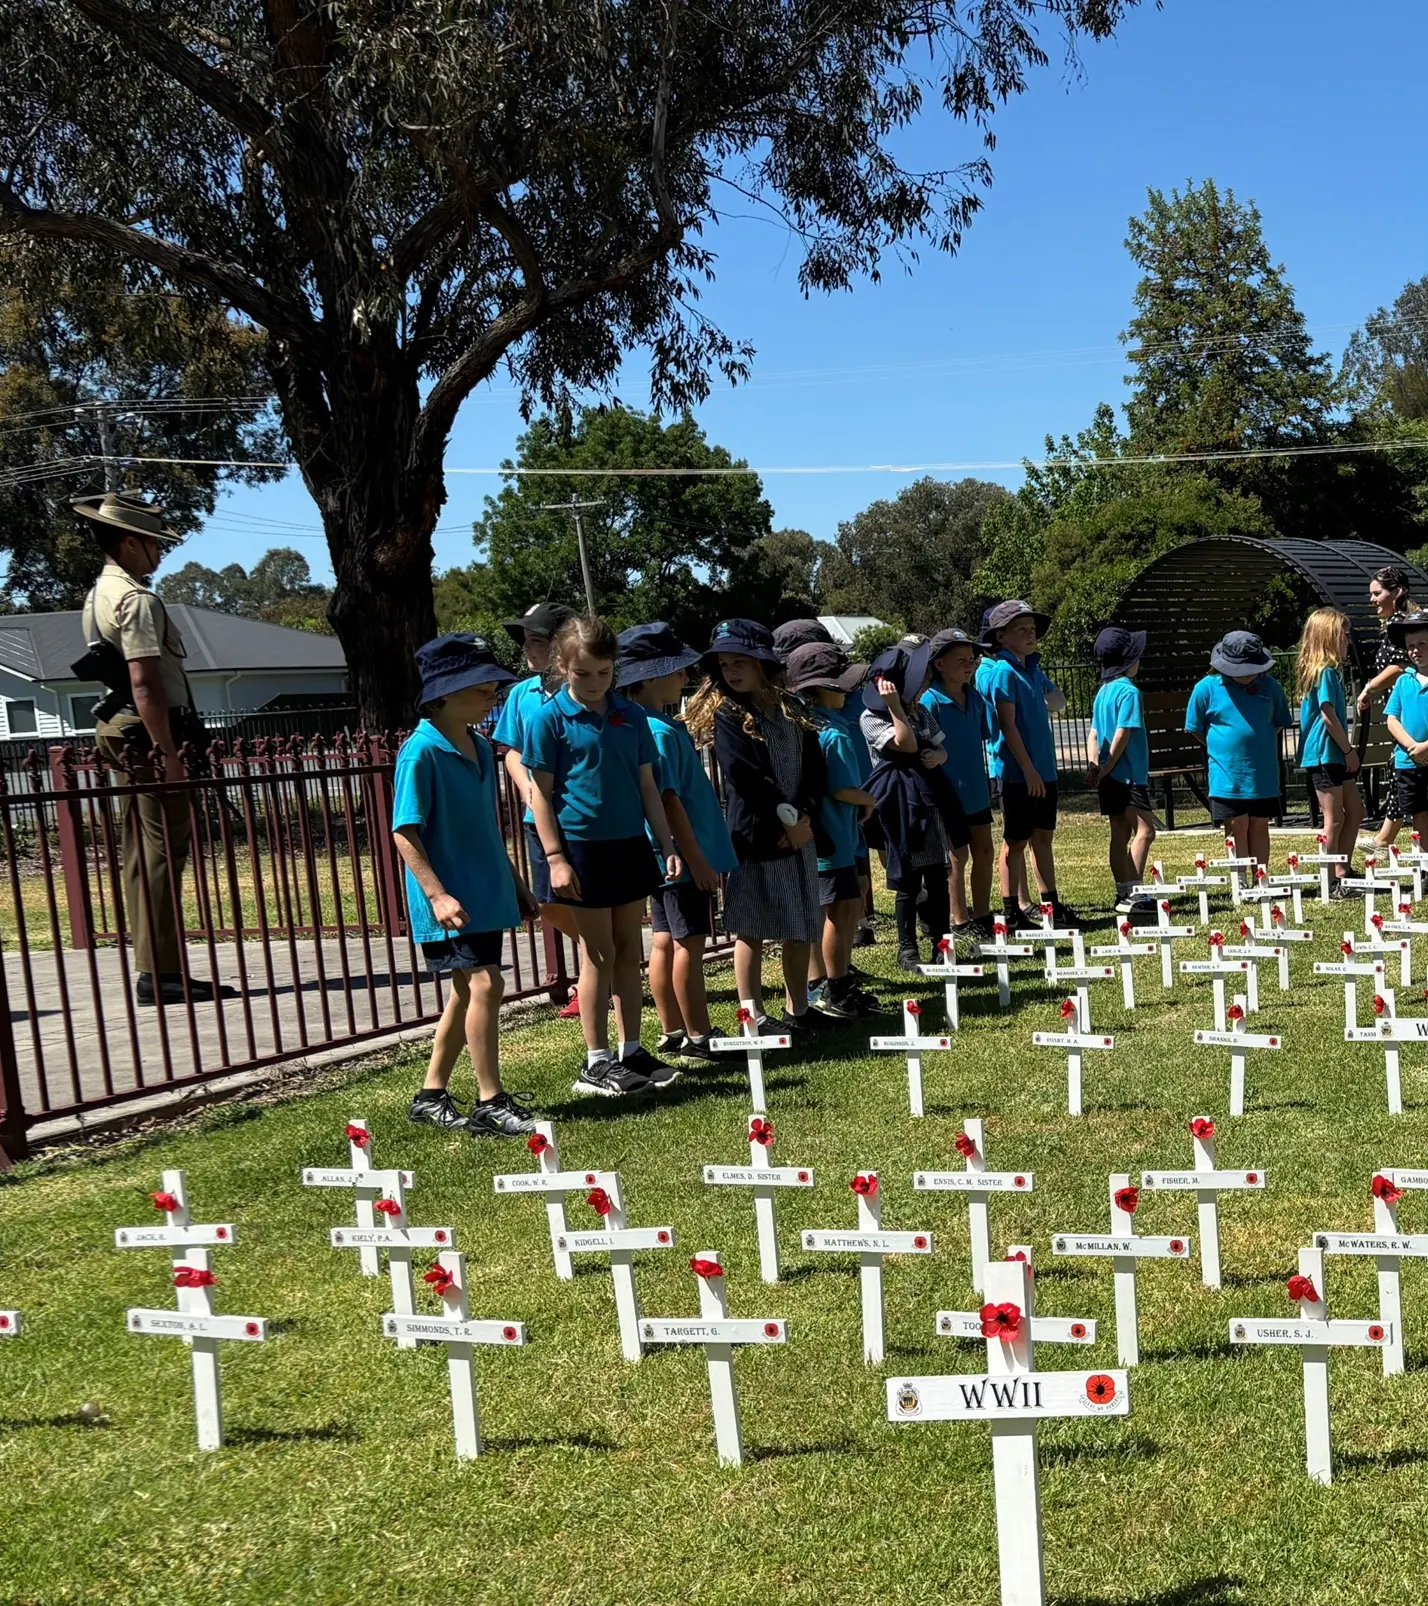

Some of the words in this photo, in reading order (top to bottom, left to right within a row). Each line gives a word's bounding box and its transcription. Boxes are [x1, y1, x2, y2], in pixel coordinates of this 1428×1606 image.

[723, 1172, 746, 1180] ELMES,
[757, 1173, 781, 1181] SISTER
[1161, 1177, 1189, 1185] FISHER,
[933, 1178, 956, 1186] ENNIS,
[977, 1179, 1003, 1187] SISTER
[351, 1234, 376, 1242] KIELY,
[574, 1238, 609, 1247] KIDGELL,
[823, 1238, 871, 1248] MATTHEWS,
[1075, 1242, 1121, 1251] McMILLAN,
[1122, 1242, 1132, 1251] W.
[1338, 1240, 1389, 1250] McWATERS,
[1391, 1241, 1400, 1249] R.
[1402, 1241, 1412, 1250] W.
[406, 1324, 453, 1336] SIMMONDS,
[454, 1327, 462, 1336] T.
[464, 1327, 473, 1336] R.
[963, 1321, 982, 1331] TOO
[664, 1327, 709, 1337] TARGETT,
[710, 1327, 720, 1336] G.
[1257, 1329, 1291, 1339] USHER,
[1294, 1329, 1303, 1338] S.
[1305, 1329, 1314, 1338] J.
[959, 1376, 1045, 1411] WWII
